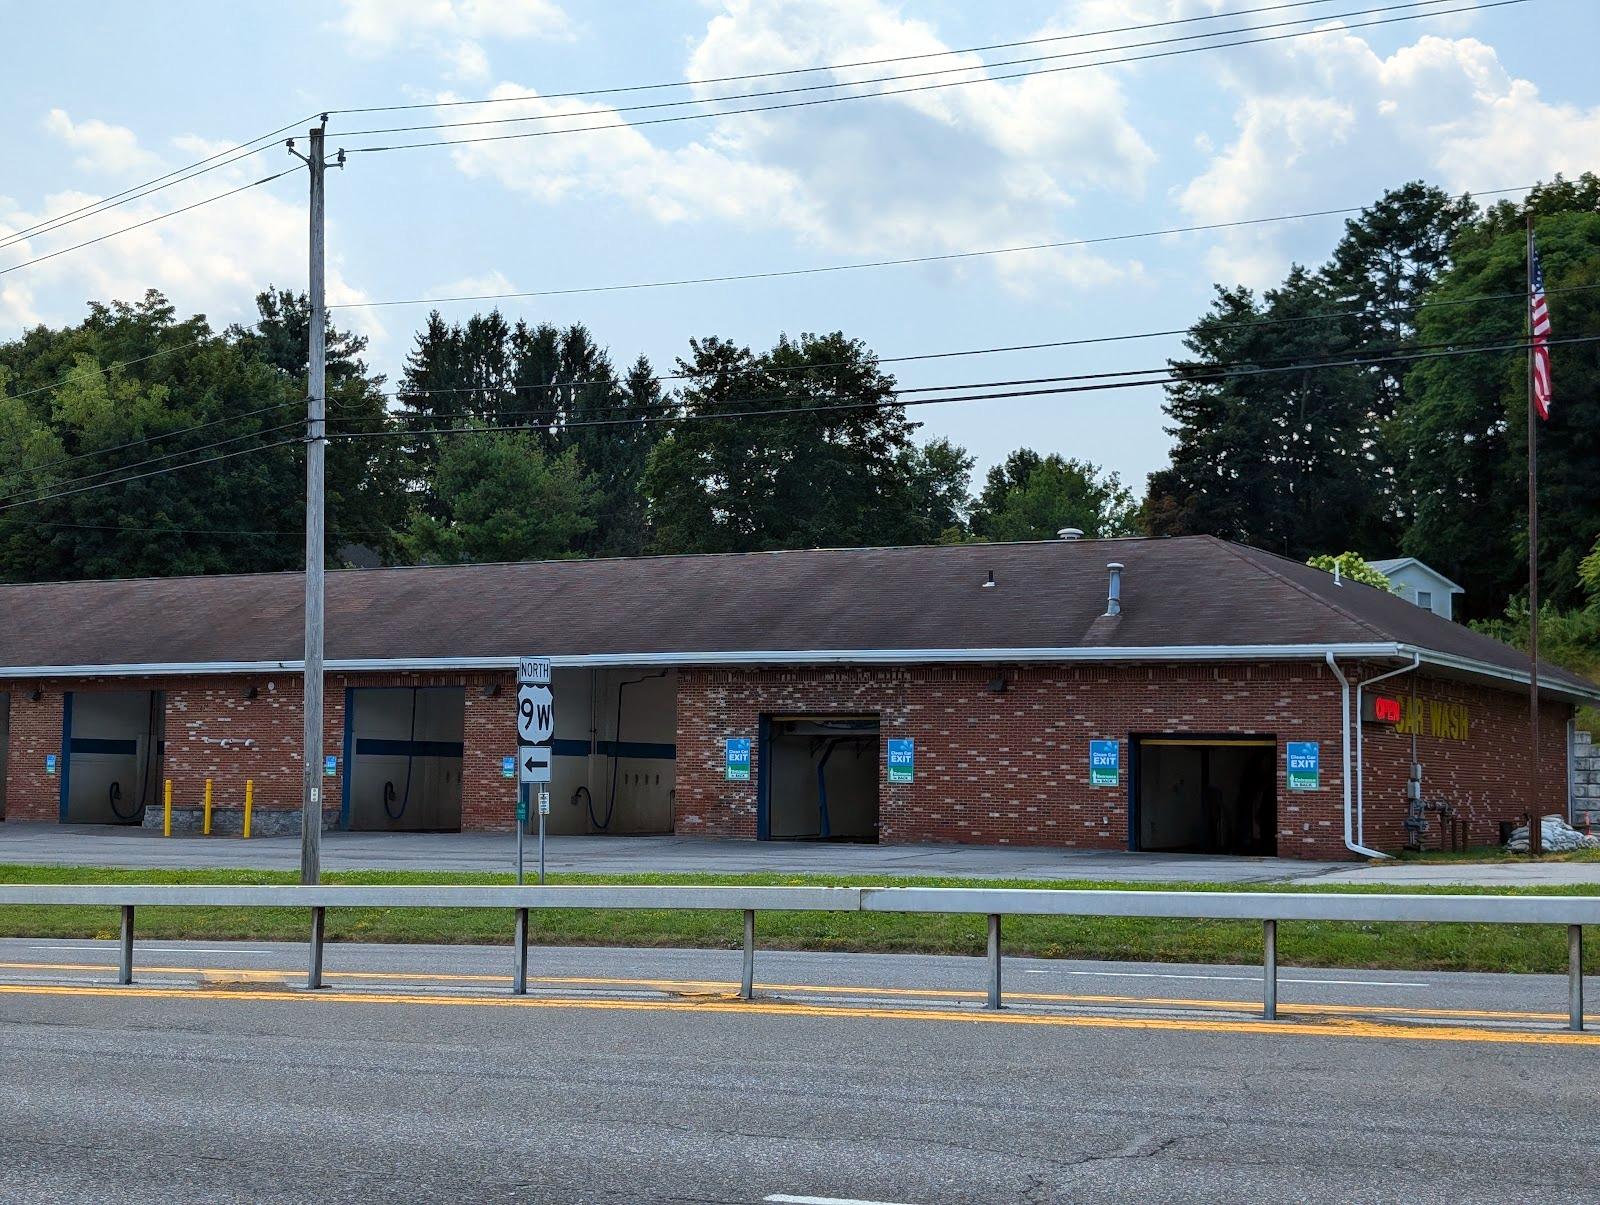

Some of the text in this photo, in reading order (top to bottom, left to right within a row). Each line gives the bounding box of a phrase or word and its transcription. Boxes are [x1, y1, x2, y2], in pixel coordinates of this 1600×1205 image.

[521, 662, 549, 678] NORTH
[1376, 697, 1400, 721] OPEN
[1430, 700, 1469, 741] WASH
[1094, 757, 1116, 765] EXIT
[1290, 760, 1316, 768] EXIT
